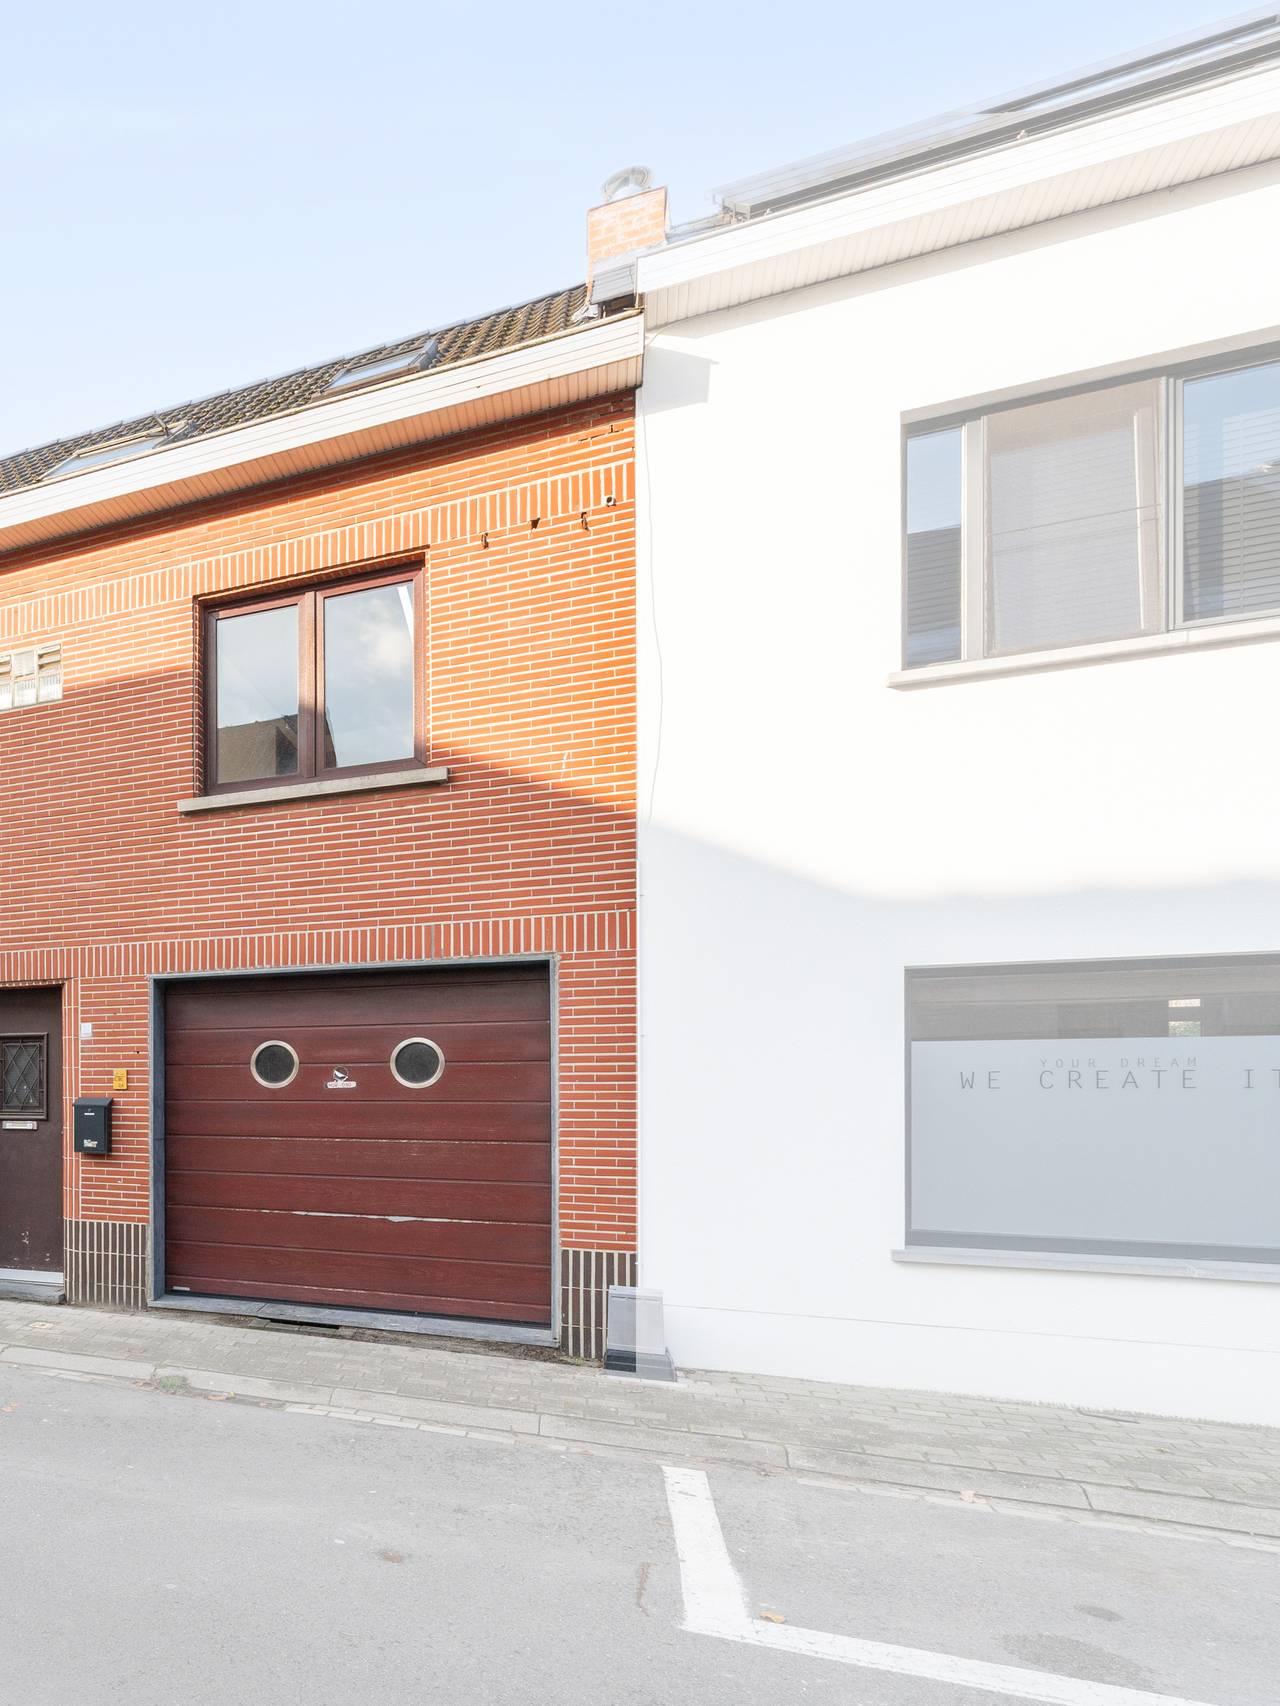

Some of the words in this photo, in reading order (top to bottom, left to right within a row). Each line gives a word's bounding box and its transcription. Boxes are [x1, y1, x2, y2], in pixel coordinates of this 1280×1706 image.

[1040, 1057, 1097, 1069] YOUR
[1120, 1056, 1198, 1068] DREAM
[959, 1070, 1002, 1089] WE
[1039, 1069, 1197, 1089] CREATE
[1242, 1068, 1280, 1089] IT
